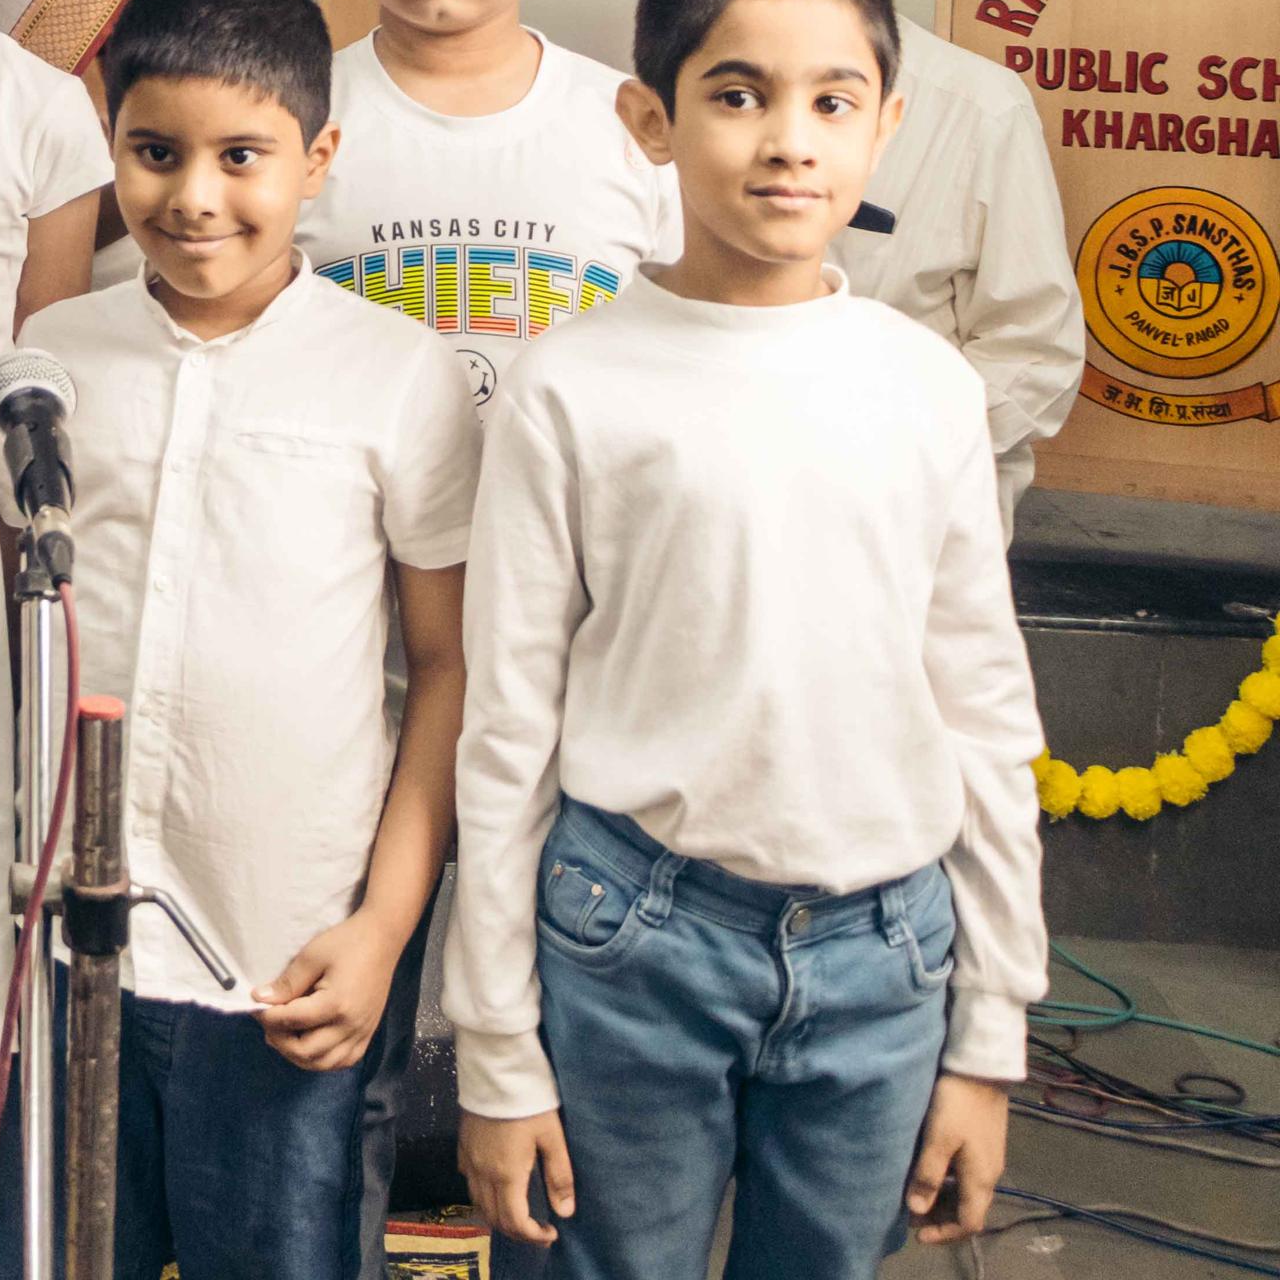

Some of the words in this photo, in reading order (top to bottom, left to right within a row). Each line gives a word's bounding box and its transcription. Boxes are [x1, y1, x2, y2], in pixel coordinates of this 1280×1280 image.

[1005, 45, 1170, 96] PUBLIC
[371, 218, 481, 244] KANSAS
[493, 219, 556, 243] CITY
